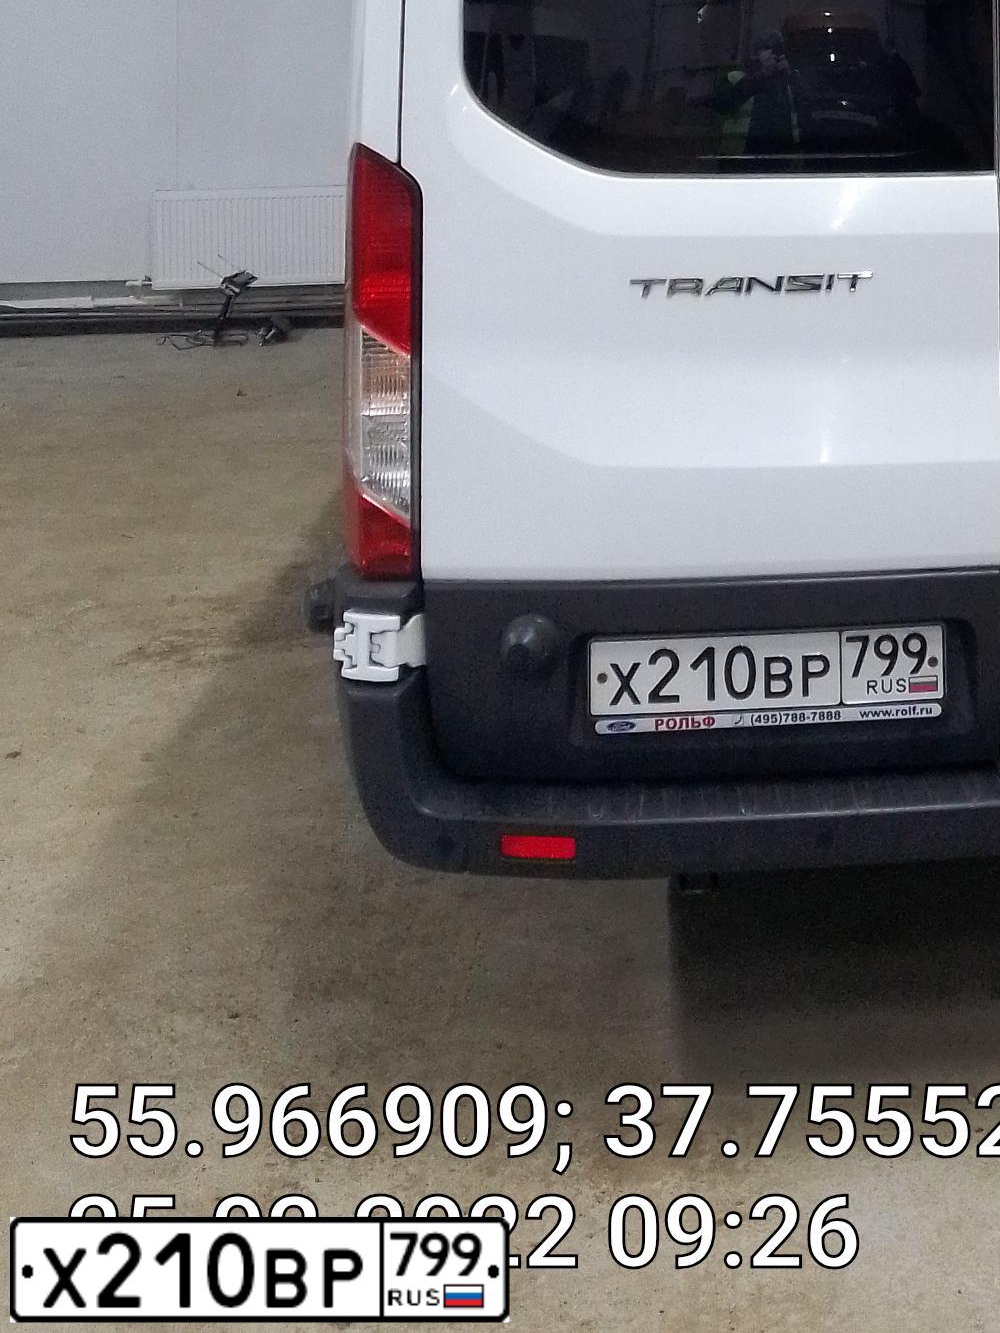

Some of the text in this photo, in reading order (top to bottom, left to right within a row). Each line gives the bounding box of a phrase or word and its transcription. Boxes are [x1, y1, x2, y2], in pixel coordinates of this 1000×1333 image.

[629, 270, 873, 298] TRANSIT
[608, 632, 928, 706] Х210ВР 799
[866, 678, 907, 696] RUS
[654, 716, 716, 731] РОЛЬФ
[750, 710, 842, 726] (495)788-7888
[859, 705, 933, 719] www.rolf.ru
